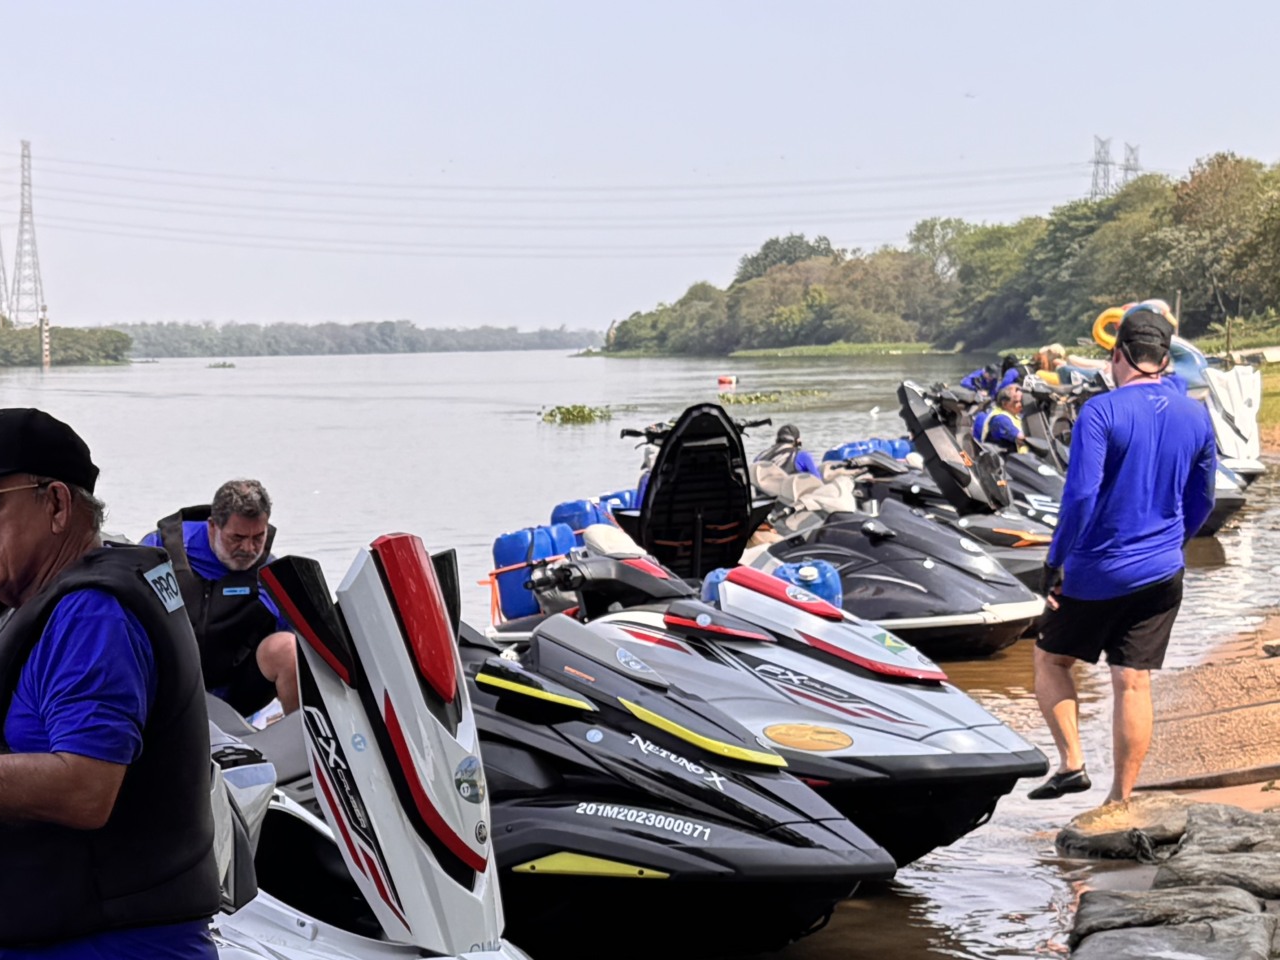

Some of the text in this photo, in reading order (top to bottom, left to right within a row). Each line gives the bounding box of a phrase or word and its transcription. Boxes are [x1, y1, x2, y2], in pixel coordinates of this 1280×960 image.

[151, 571, 179, 603] PRO
[303, 705, 347, 770] FX
[628, 732, 728, 791] NETUNO X
[575, 802, 711, 841] 201M2023000971
